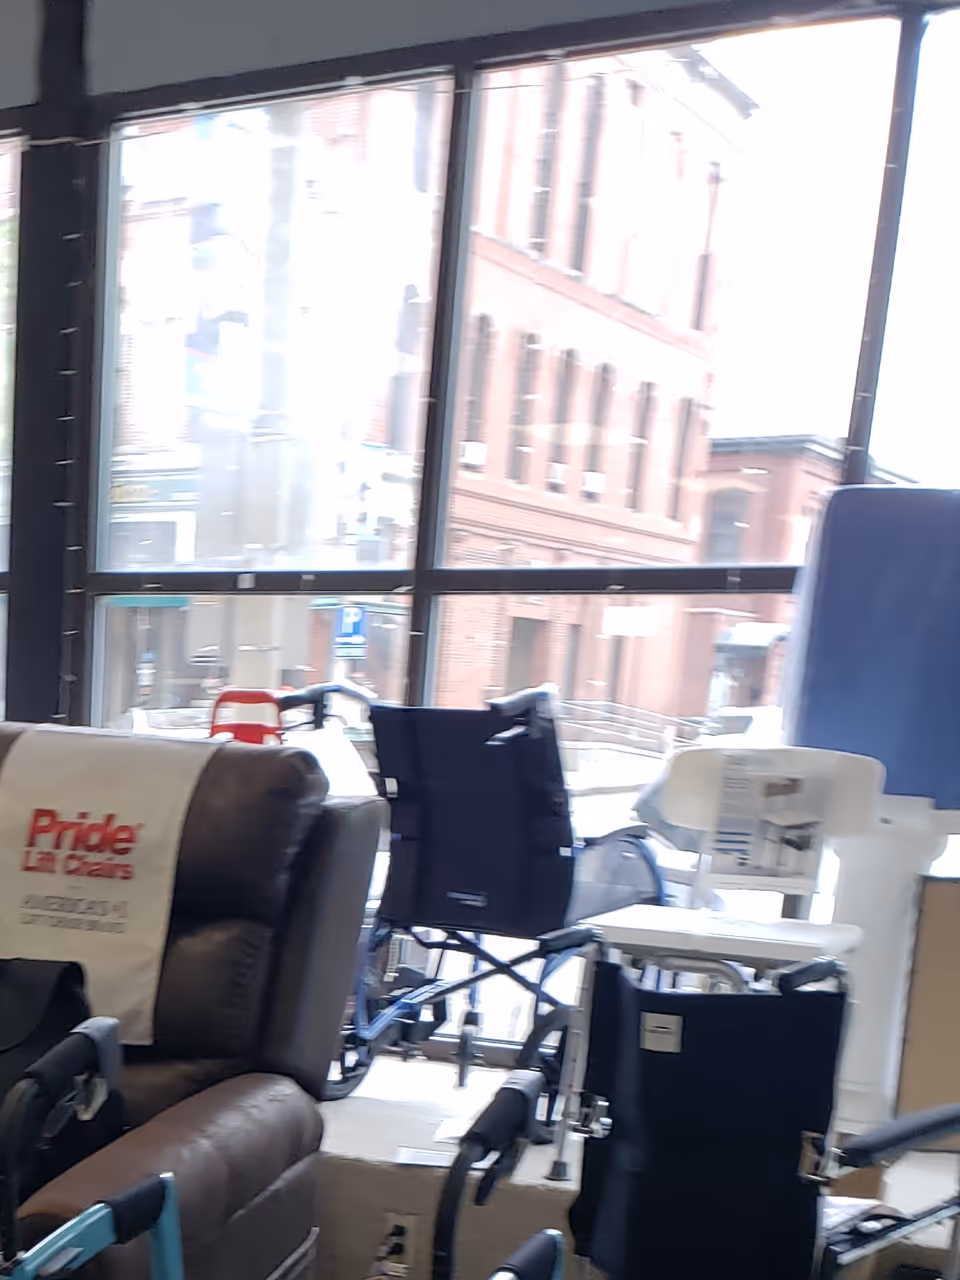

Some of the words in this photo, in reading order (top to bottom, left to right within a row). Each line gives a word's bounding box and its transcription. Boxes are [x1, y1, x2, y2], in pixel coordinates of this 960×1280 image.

[26, 808, 136, 855] Pride
[21, 849, 56, 873] Lift
[64, 853, 134, 880] Chairs
